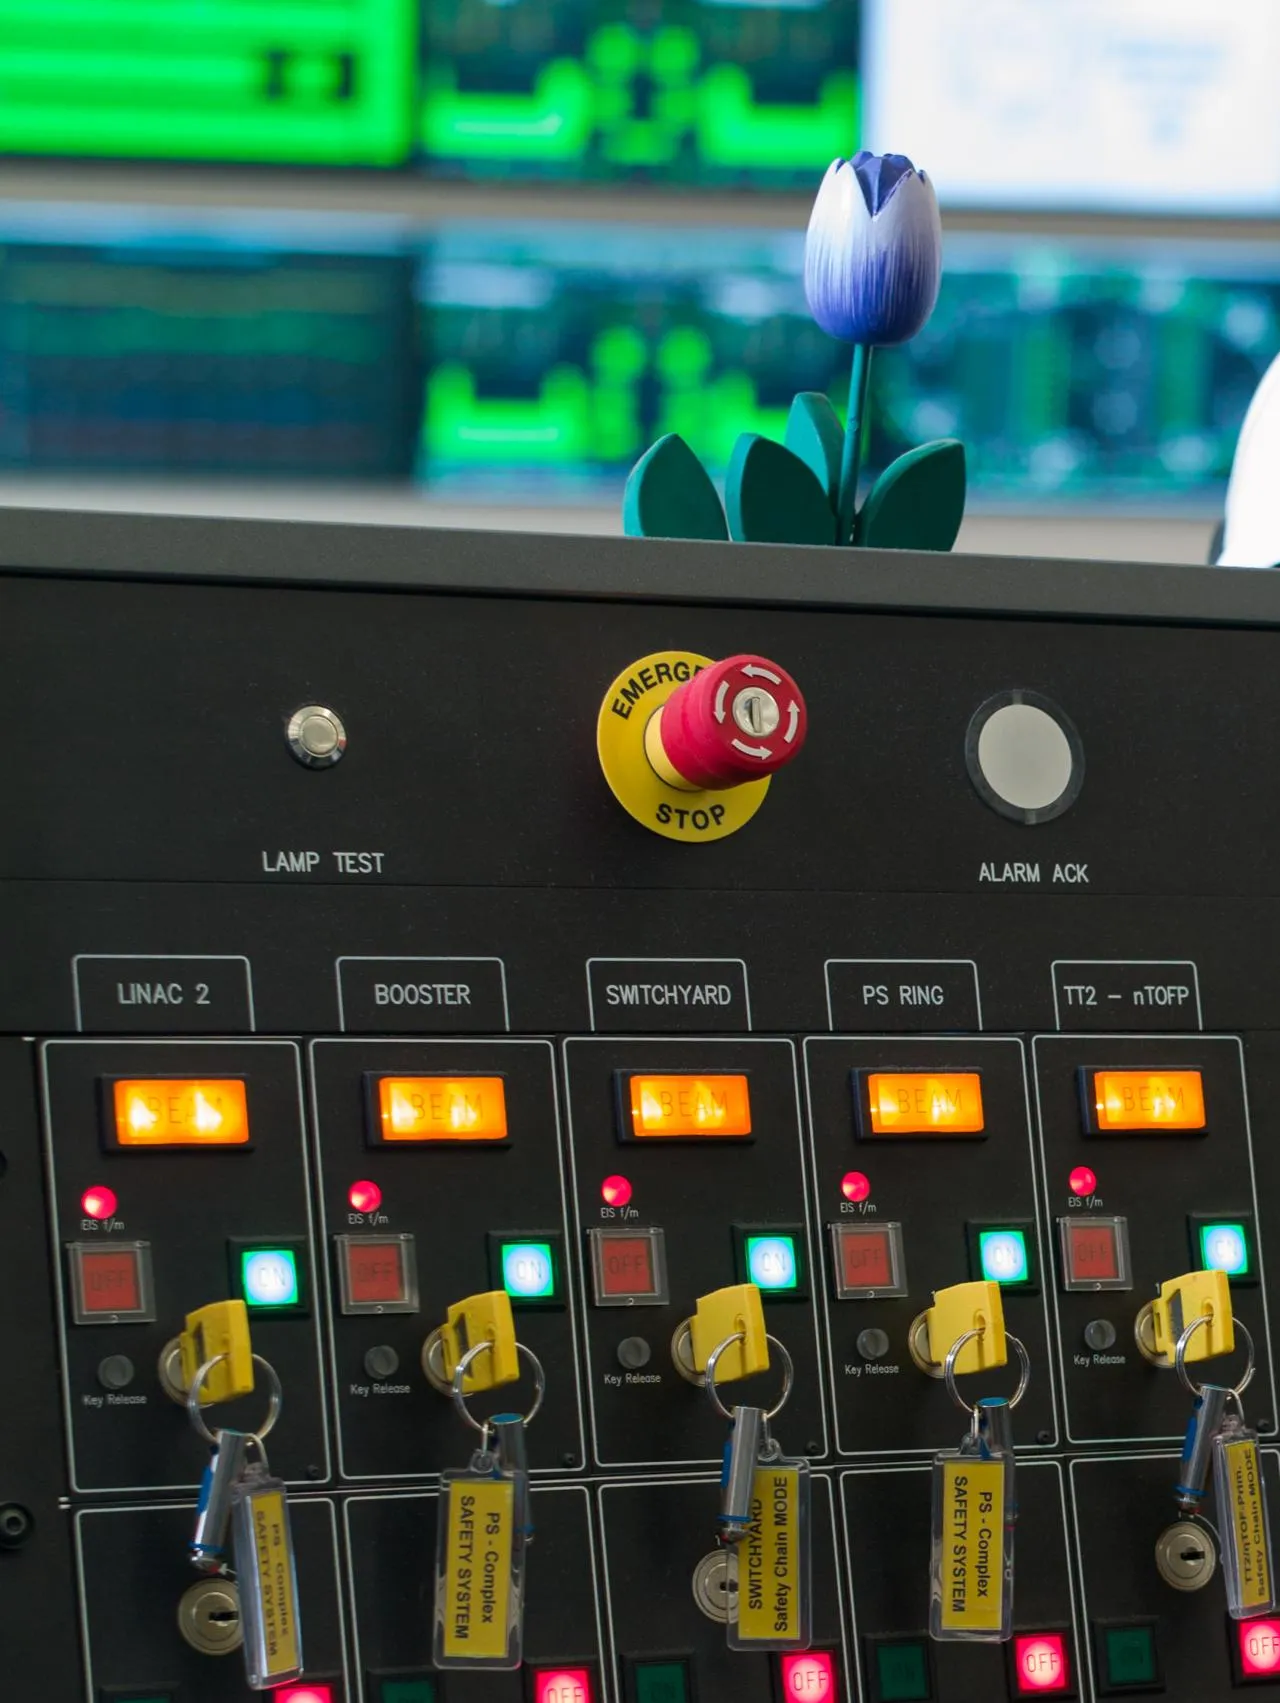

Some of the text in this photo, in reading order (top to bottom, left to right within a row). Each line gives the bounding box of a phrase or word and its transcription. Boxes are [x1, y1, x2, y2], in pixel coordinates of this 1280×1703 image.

[656, 803, 725, 830] STOP
[262, 851, 385, 873] LAMP TEST
[979, 862, 1089, 883] ALARM ACK
[118, 983, 211, 1004] LINAC 2
[374, 983, 473, 1005] BOOSTER
[606, 984, 731, 1005] SWITCHYARD
[863, 984, 944, 1005] PS RING
[1063, 986, 1097, 1005] TT2
[1133, 986, 1189, 1005] nTOFP
[411, 1094, 484, 1120] BEAM
[660, 1091, 729, 1117] BEAM
[896, 1087, 964, 1114] BEAM
[1123, 1085, 1186, 1111] BEAM
[601, 1207, 616, 1218] EIS
[840, 1202, 855, 1213] EIS
[608, 1256, 643, 1275] OFF
[761, 1252, 787, 1272] ON
[850, 1249, 881, 1267] OFF
[993, 1247, 1018, 1265] ON
[258, 1267, 286, 1287] ON
[514, 1260, 542, 1280] ON
[845, 1363, 899, 1377] Key Release
[1073, 1354, 1126, 1368] Key Release
[350, 1383, 411, 1396] Key Release
[603, 1372, 662, 1386] Key Release
[979, 1492, 992, 1514] PS
[487, 1512, 500, 1535] PS
[1244, 1449, 1266, 1598] Safety Chain MODE
[774, 1476, 791, 1632] Safety Chain MODE
[952, 1475, 968, 1613] SAFETY SYSTEM
[455, 1495, 475, 1640] SAFETY SYSTEM
[978, 1528, 992, 1597] Complex
[256, 1510, 278, 1657] SAFETY SYSTEM
[481, 1551, 499, 1624] Complex
[1248, 1636, 1280, 1657] OFF
[1026, 1653, 1058, 1673] OFF
[793, 1671, 829, 1693] OFF
